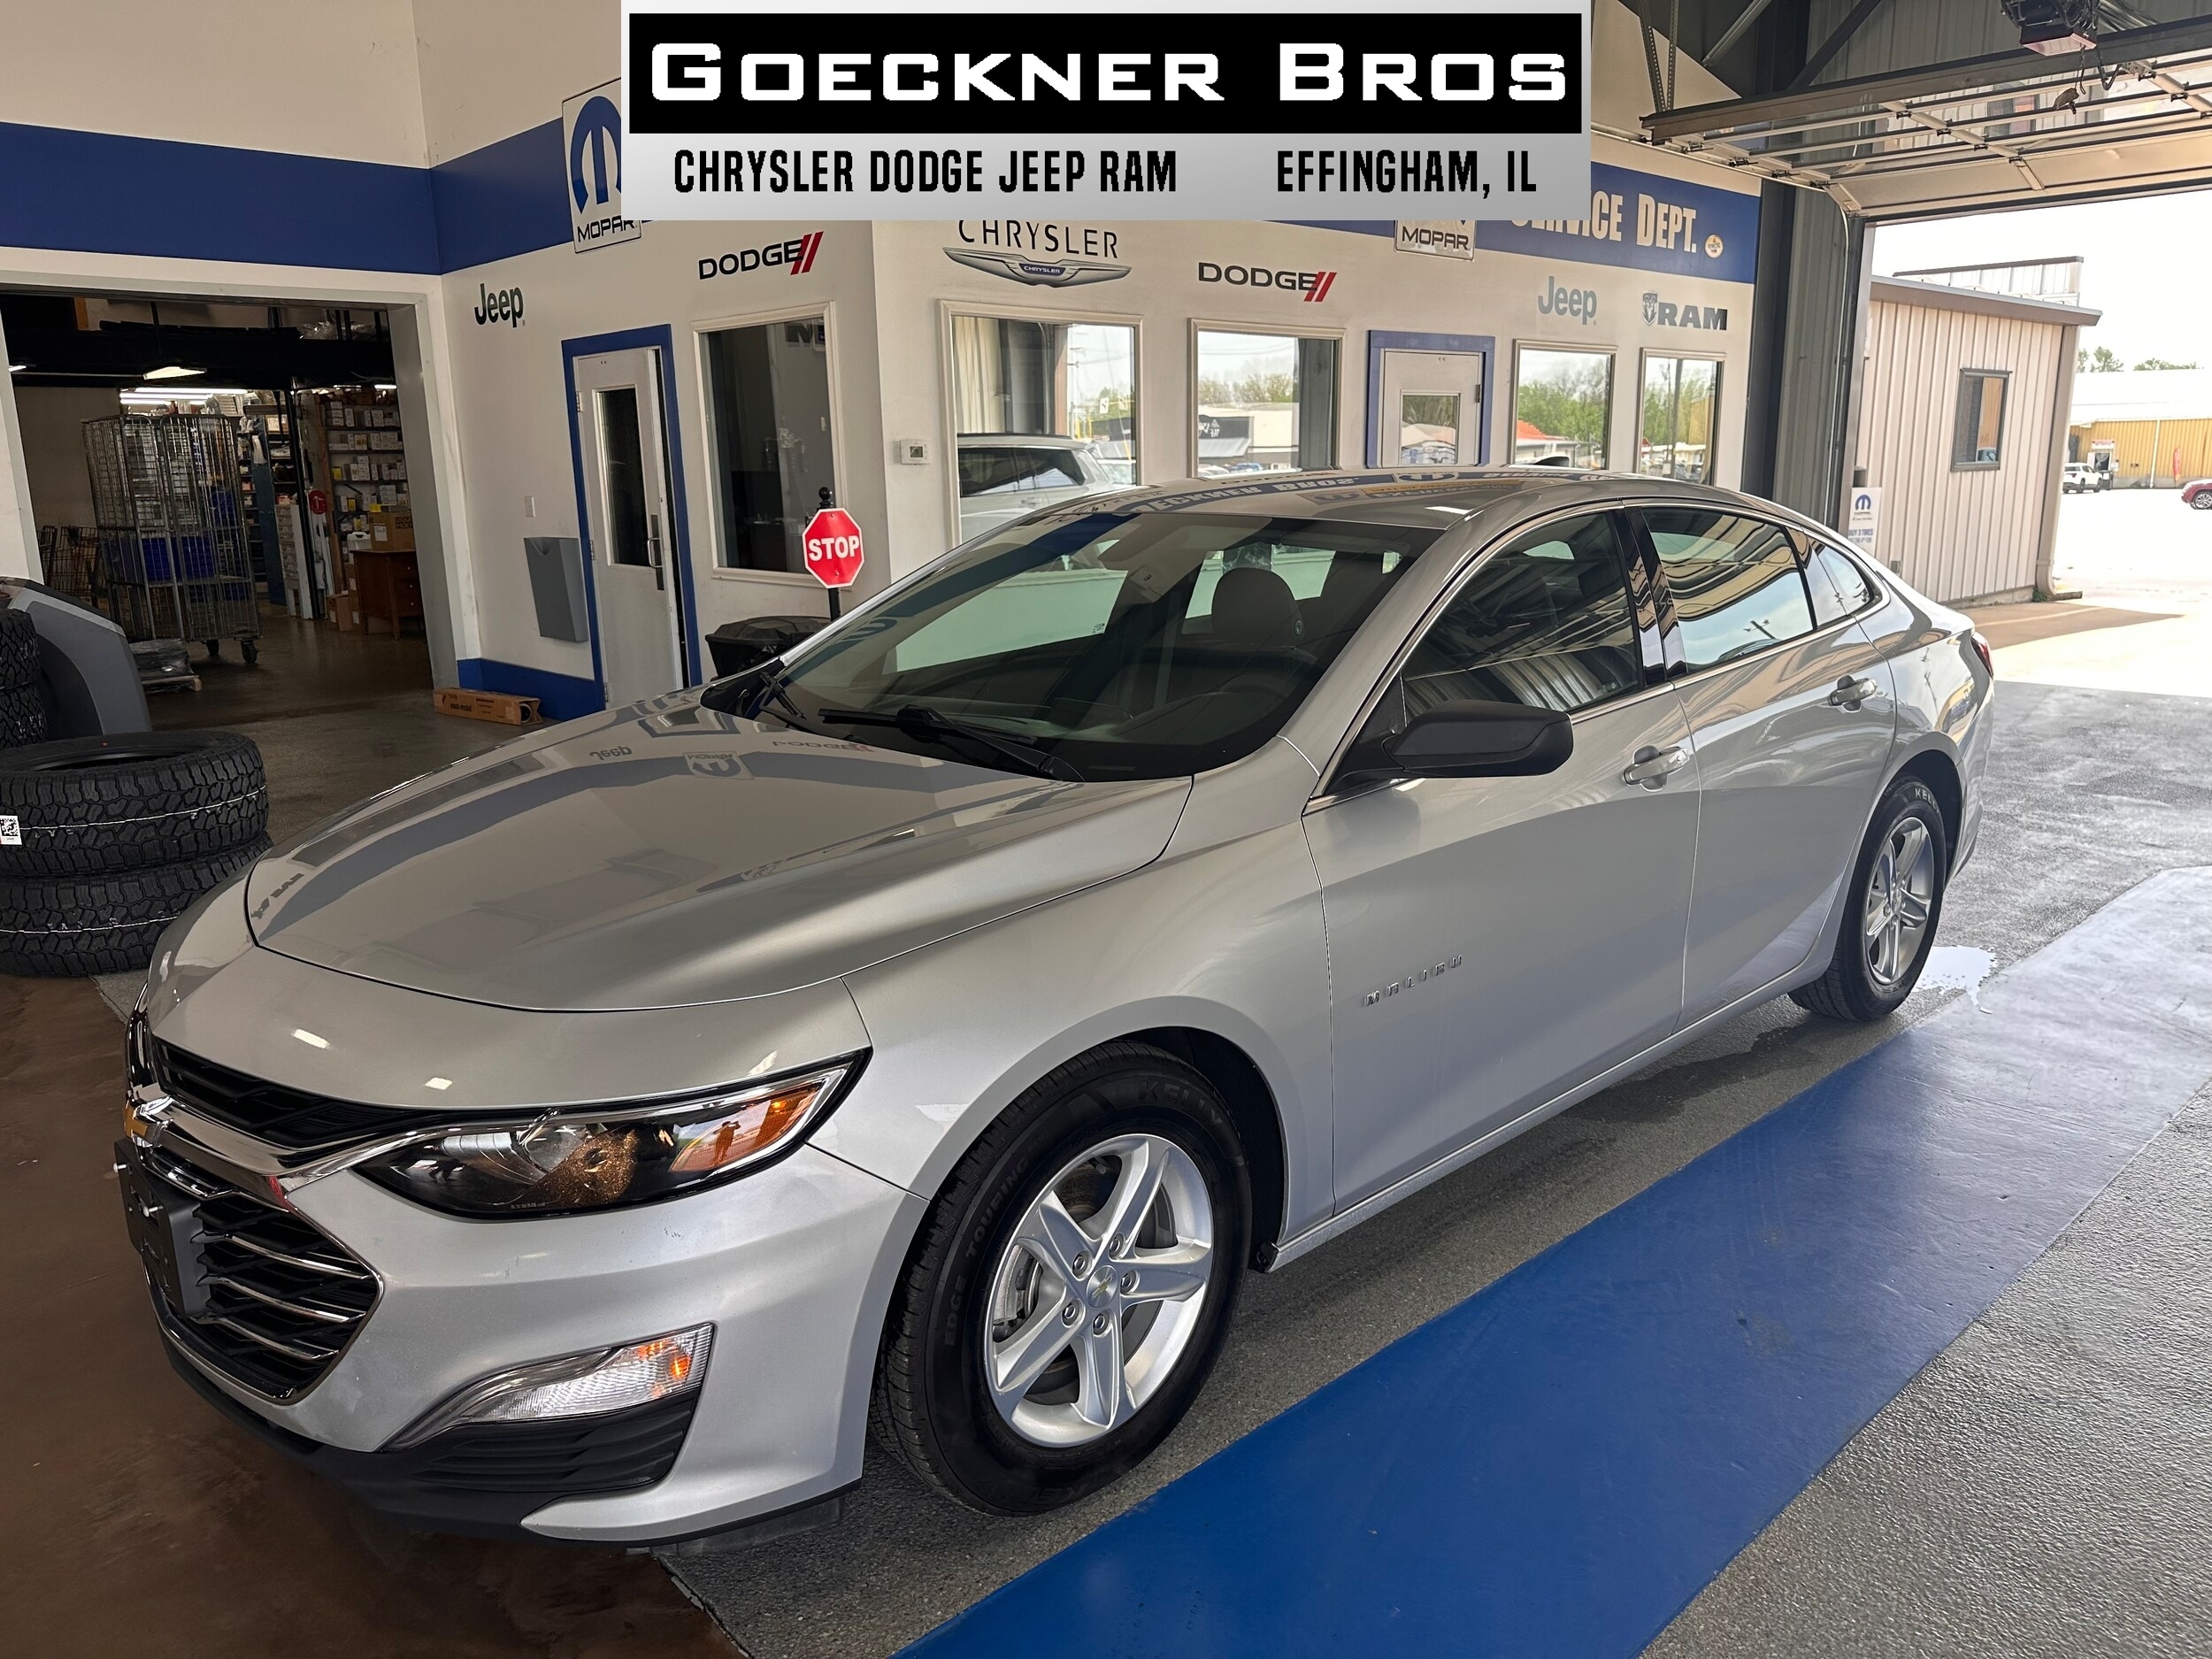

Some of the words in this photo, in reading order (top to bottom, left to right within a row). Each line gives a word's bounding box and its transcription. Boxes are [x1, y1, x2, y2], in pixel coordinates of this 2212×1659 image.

[577, 215, 635, 242] MOPAR
[958, 220, 1118, 259] CHRYSLER
[1402, 227, 1469, 250] MOPAR
[1637, 193, 1697, 253] DEPT.
[698, 239, 804, 280] DODGE
[1024, 265, 1061, 274] CHRYSLER
[1198, 262, 1318, 291] DODGE
[474, 282, 524, 327] Jeep
[1538, 276, 1597, 325] Jeep
[1657, 302, 1728, 331] RAM
[808, 536, 860, 562] STOP
[1364, 955, 1462, 1007] MALIBU
